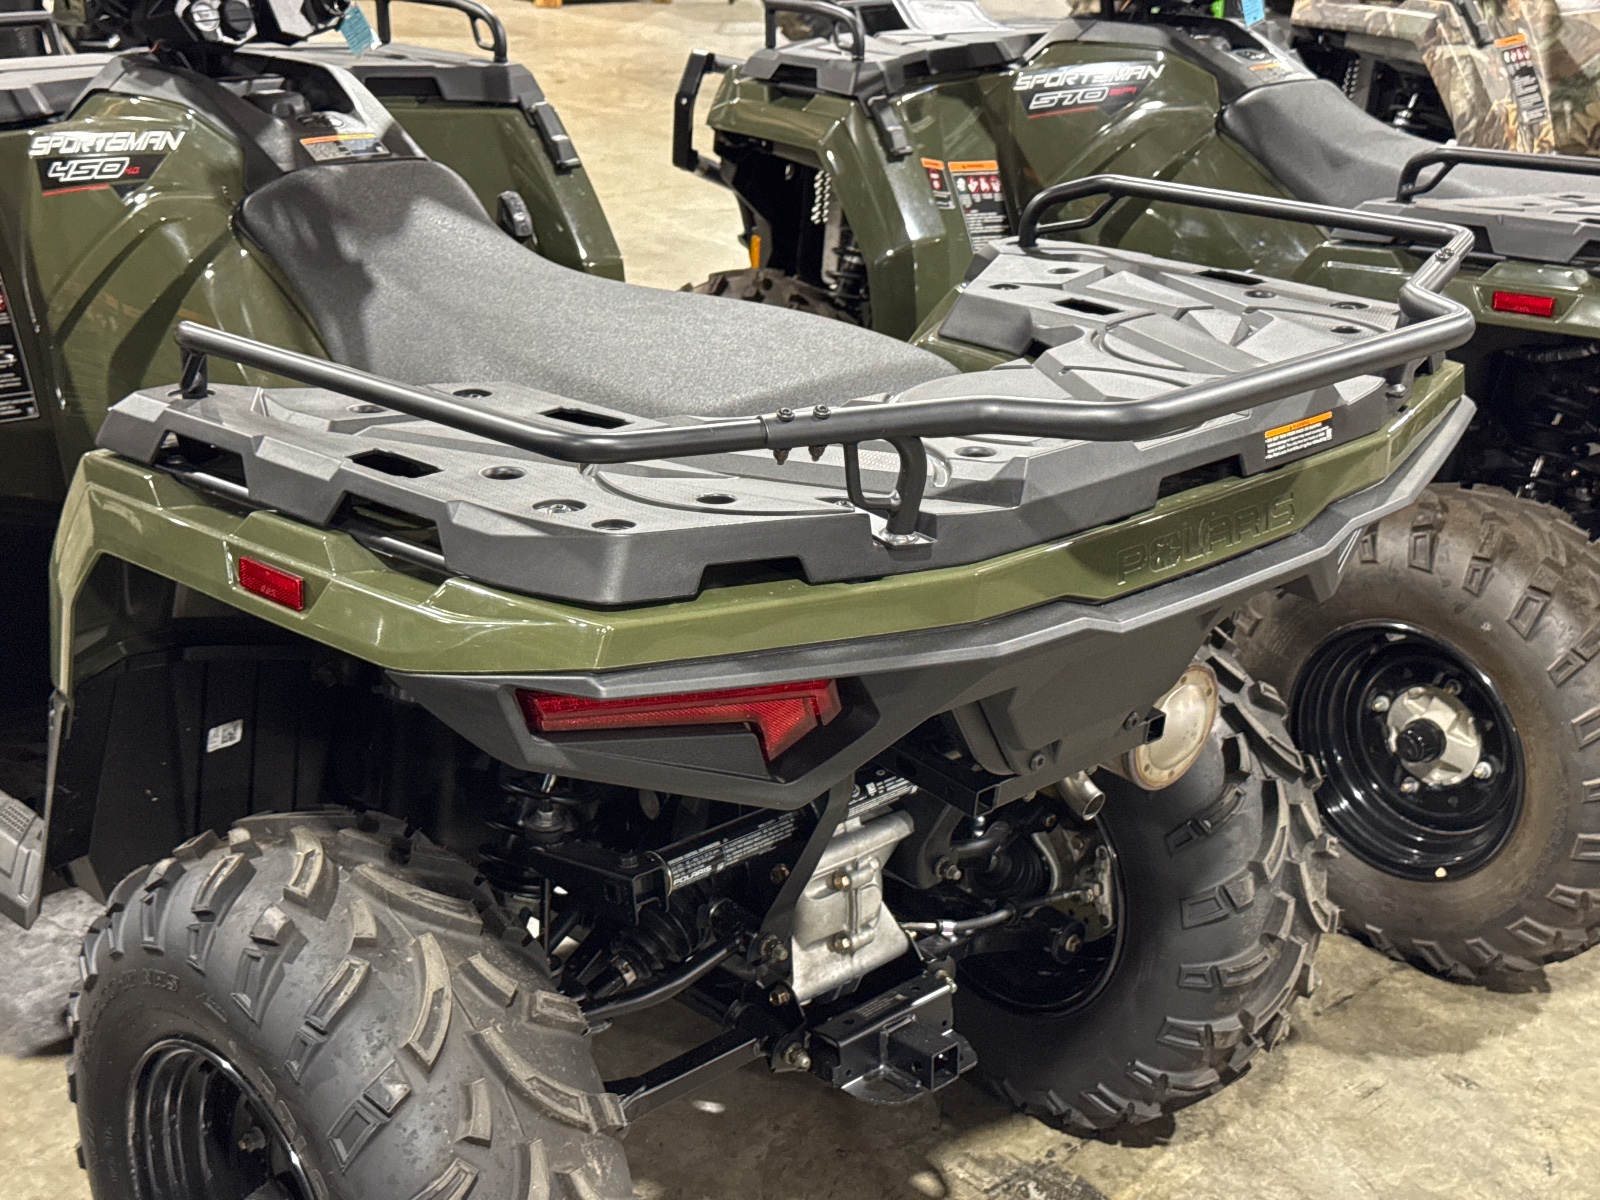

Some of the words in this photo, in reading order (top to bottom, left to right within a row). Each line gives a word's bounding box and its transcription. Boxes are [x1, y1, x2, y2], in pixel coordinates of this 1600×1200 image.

[1013, 63, 1165, 91] SPORTSMAN
[1029, 86, 1109, 110] 570
[29, 130, 186, 158] SPORTSMAN
[48, 156, 130, 182] 450
[1117, 491, 1296, 585] POLARIS
[673, 865, 712, 886] POLARIS
